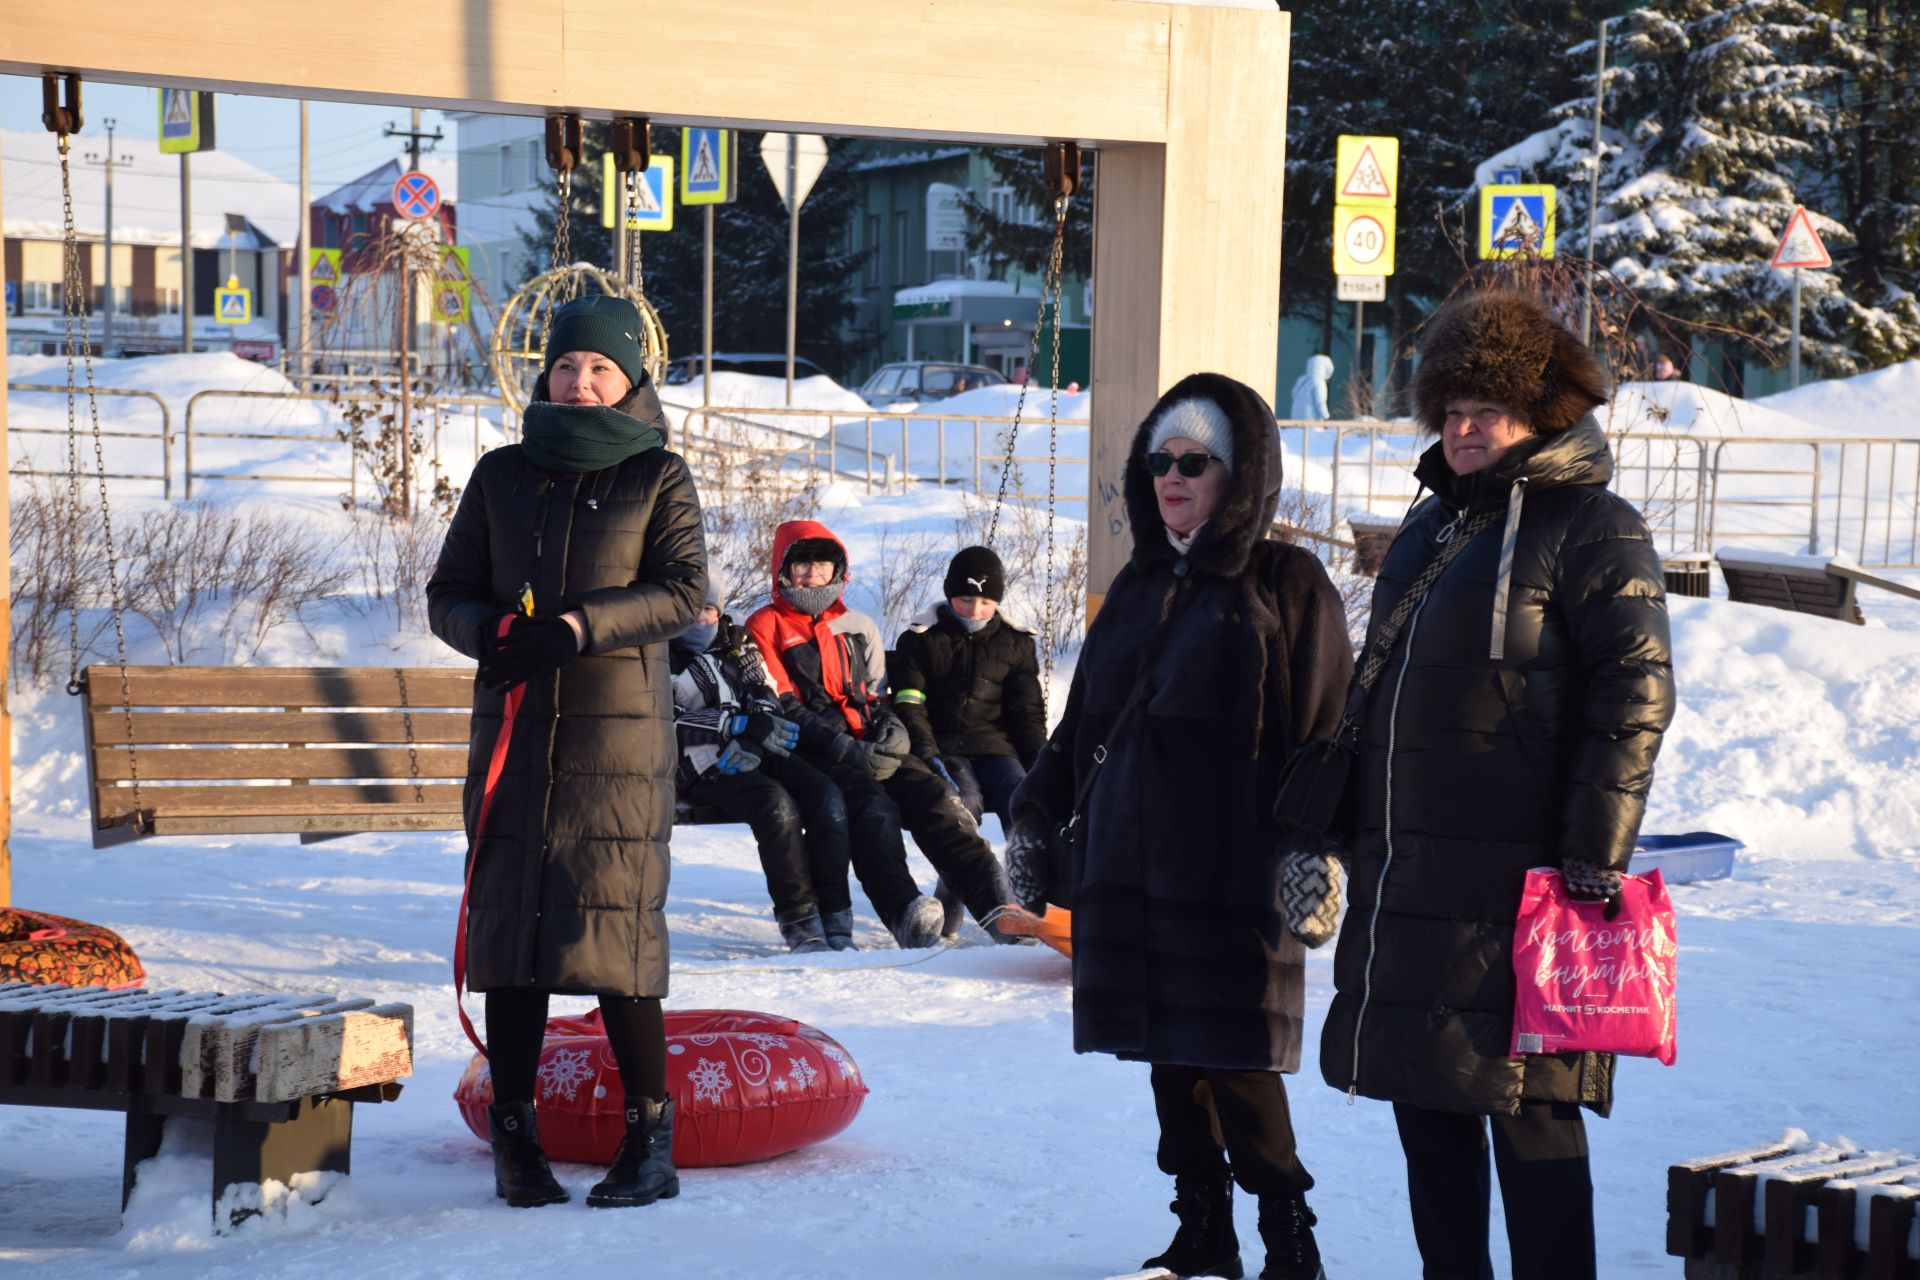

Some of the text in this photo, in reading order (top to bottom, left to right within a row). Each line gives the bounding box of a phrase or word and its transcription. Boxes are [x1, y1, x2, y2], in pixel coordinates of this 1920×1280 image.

[1353, 231, 1377, 250] 40
[1527, 917, 1657, 955] Красота
[1543, 1004, 1650, 1015] МАГНИТ КОСМЕТИК
[503, 1115, 518, 1132] G
[626, 1108, 639, 1124] G
